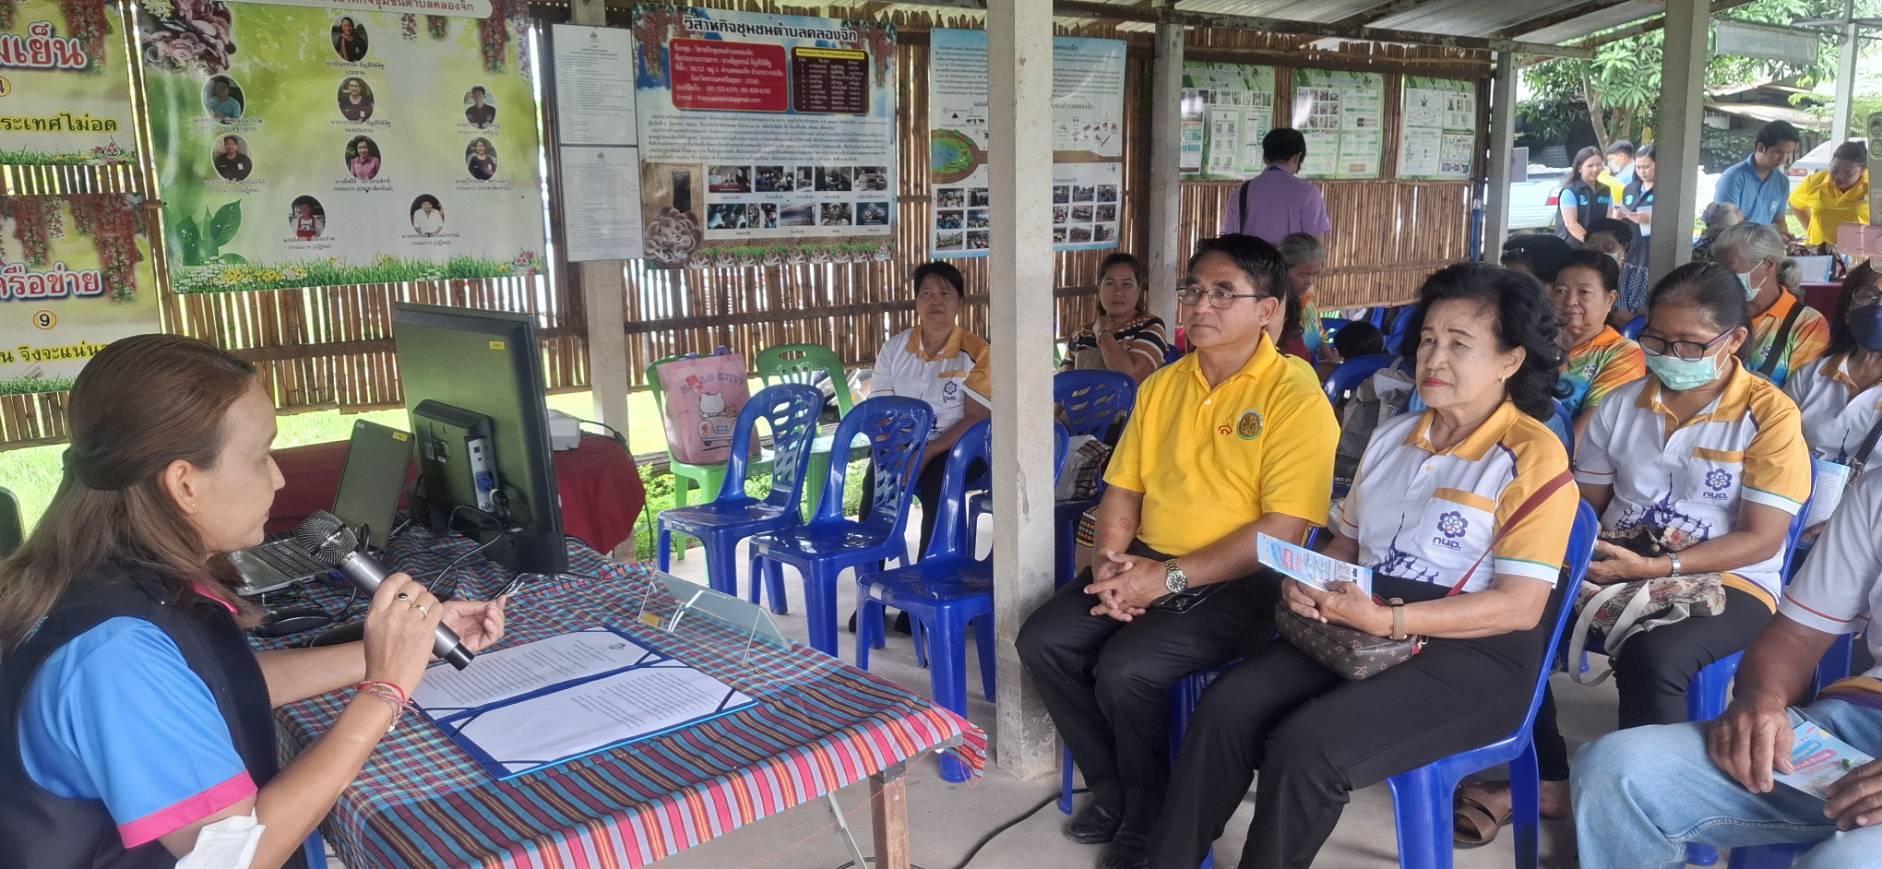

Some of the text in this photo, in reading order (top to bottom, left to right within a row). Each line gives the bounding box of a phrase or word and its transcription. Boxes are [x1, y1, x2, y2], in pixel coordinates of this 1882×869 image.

[684, 15, 856, 41] วิสาหกิจชุมชนตำบลคลองจิก
[39, 313, 50, 327] 9
[19, 340, 109, 361] จึงจะแน่น
